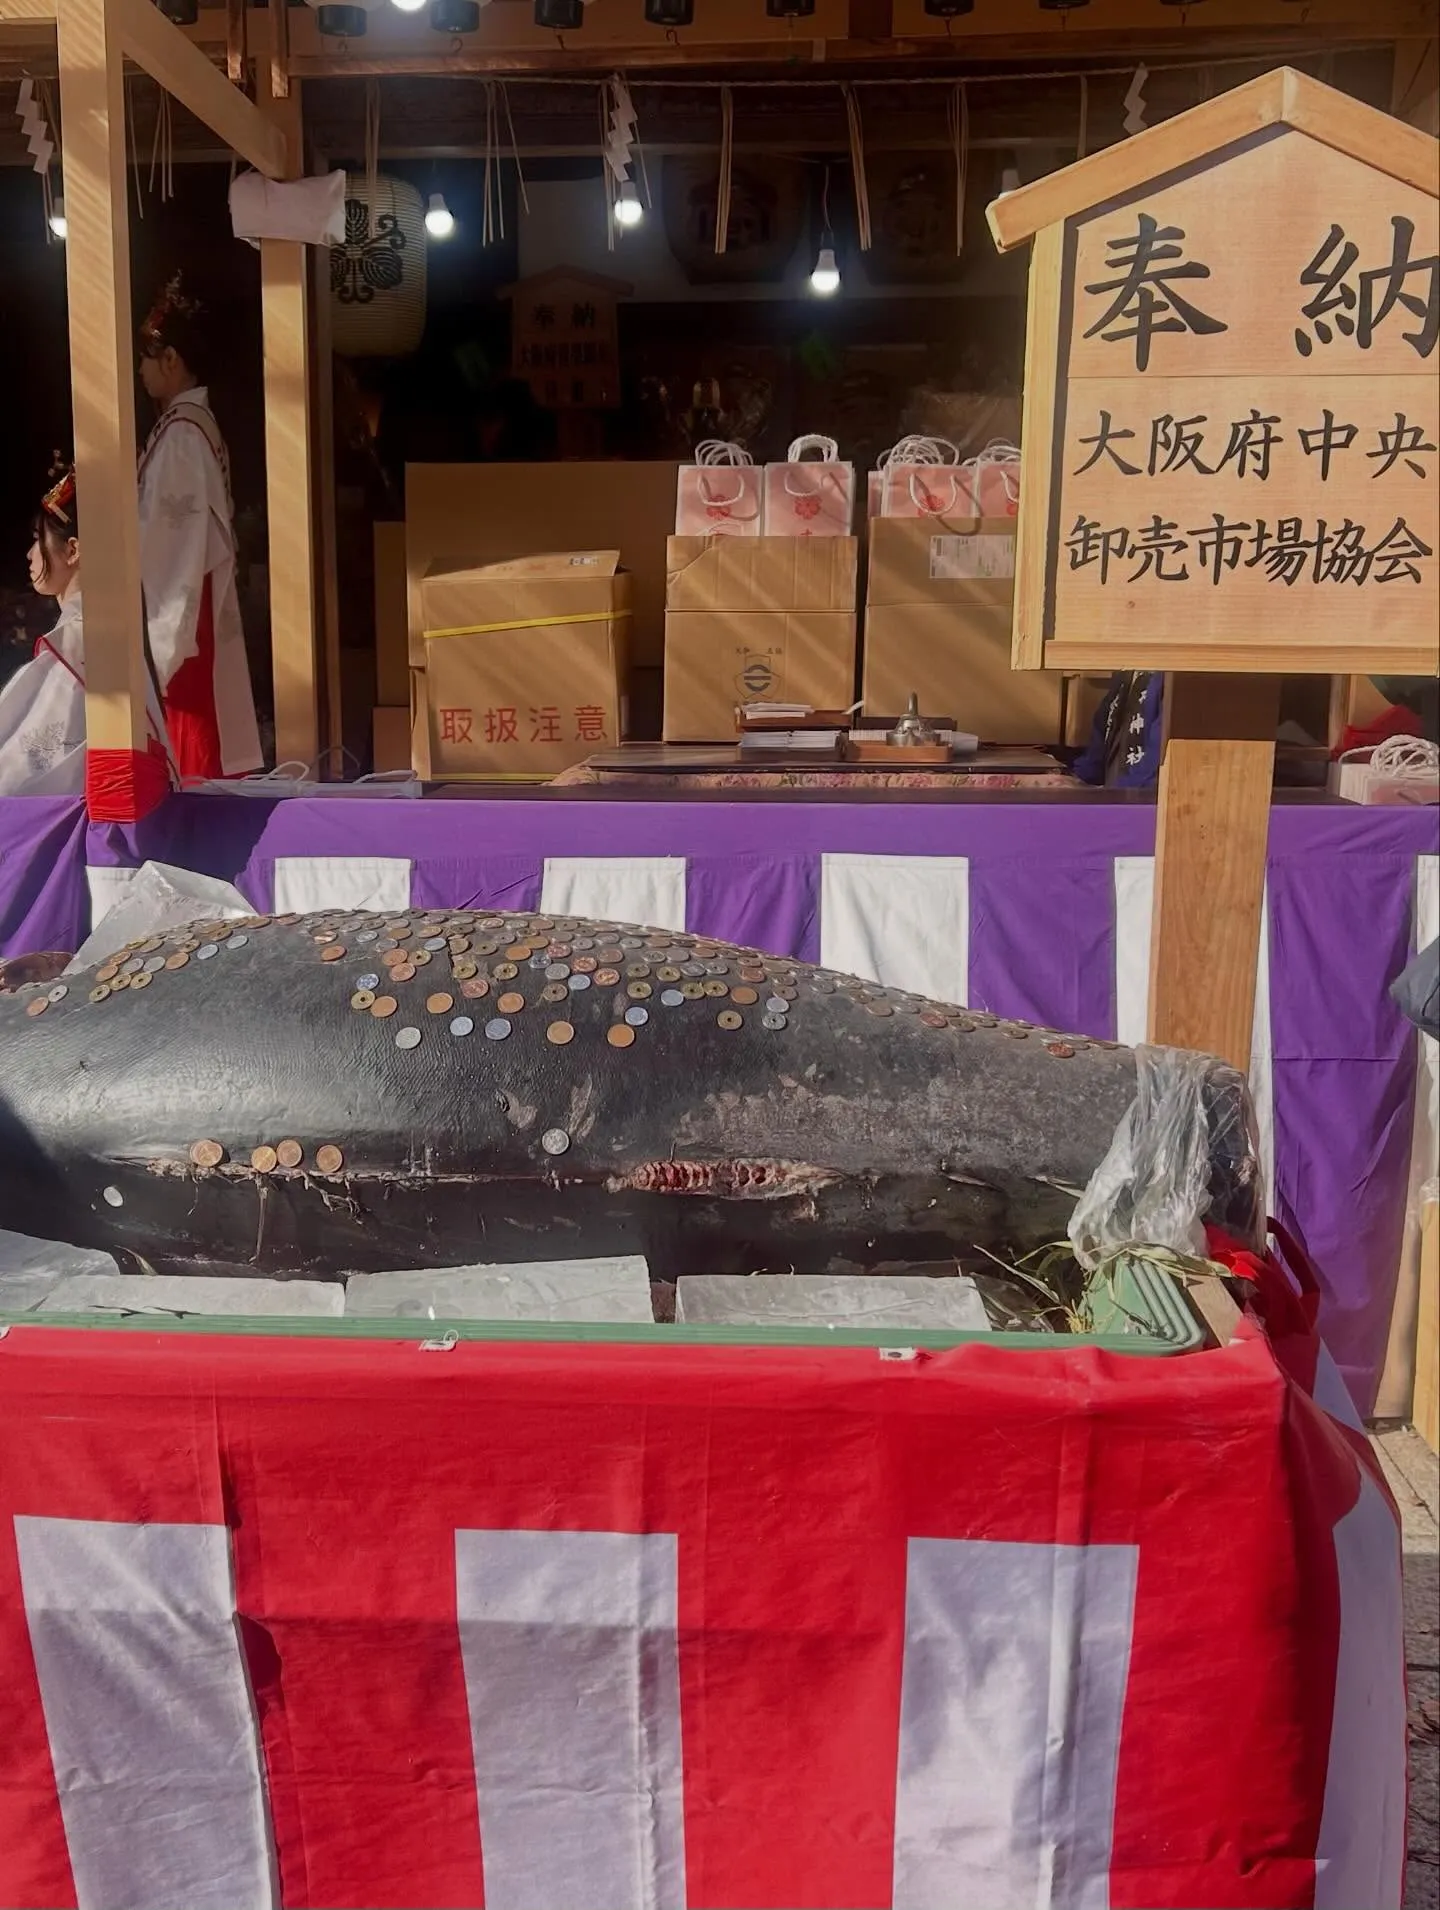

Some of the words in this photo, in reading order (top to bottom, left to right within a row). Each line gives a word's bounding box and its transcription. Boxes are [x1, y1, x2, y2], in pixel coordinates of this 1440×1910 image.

[1082, 213, 1439, 373] 奉納
[1073, 409, 1437, 481] 大阪府中央
[1064, 513, 1433, 586] 卸売市場協会
[439, 704, 608, 745] 取扱注意
